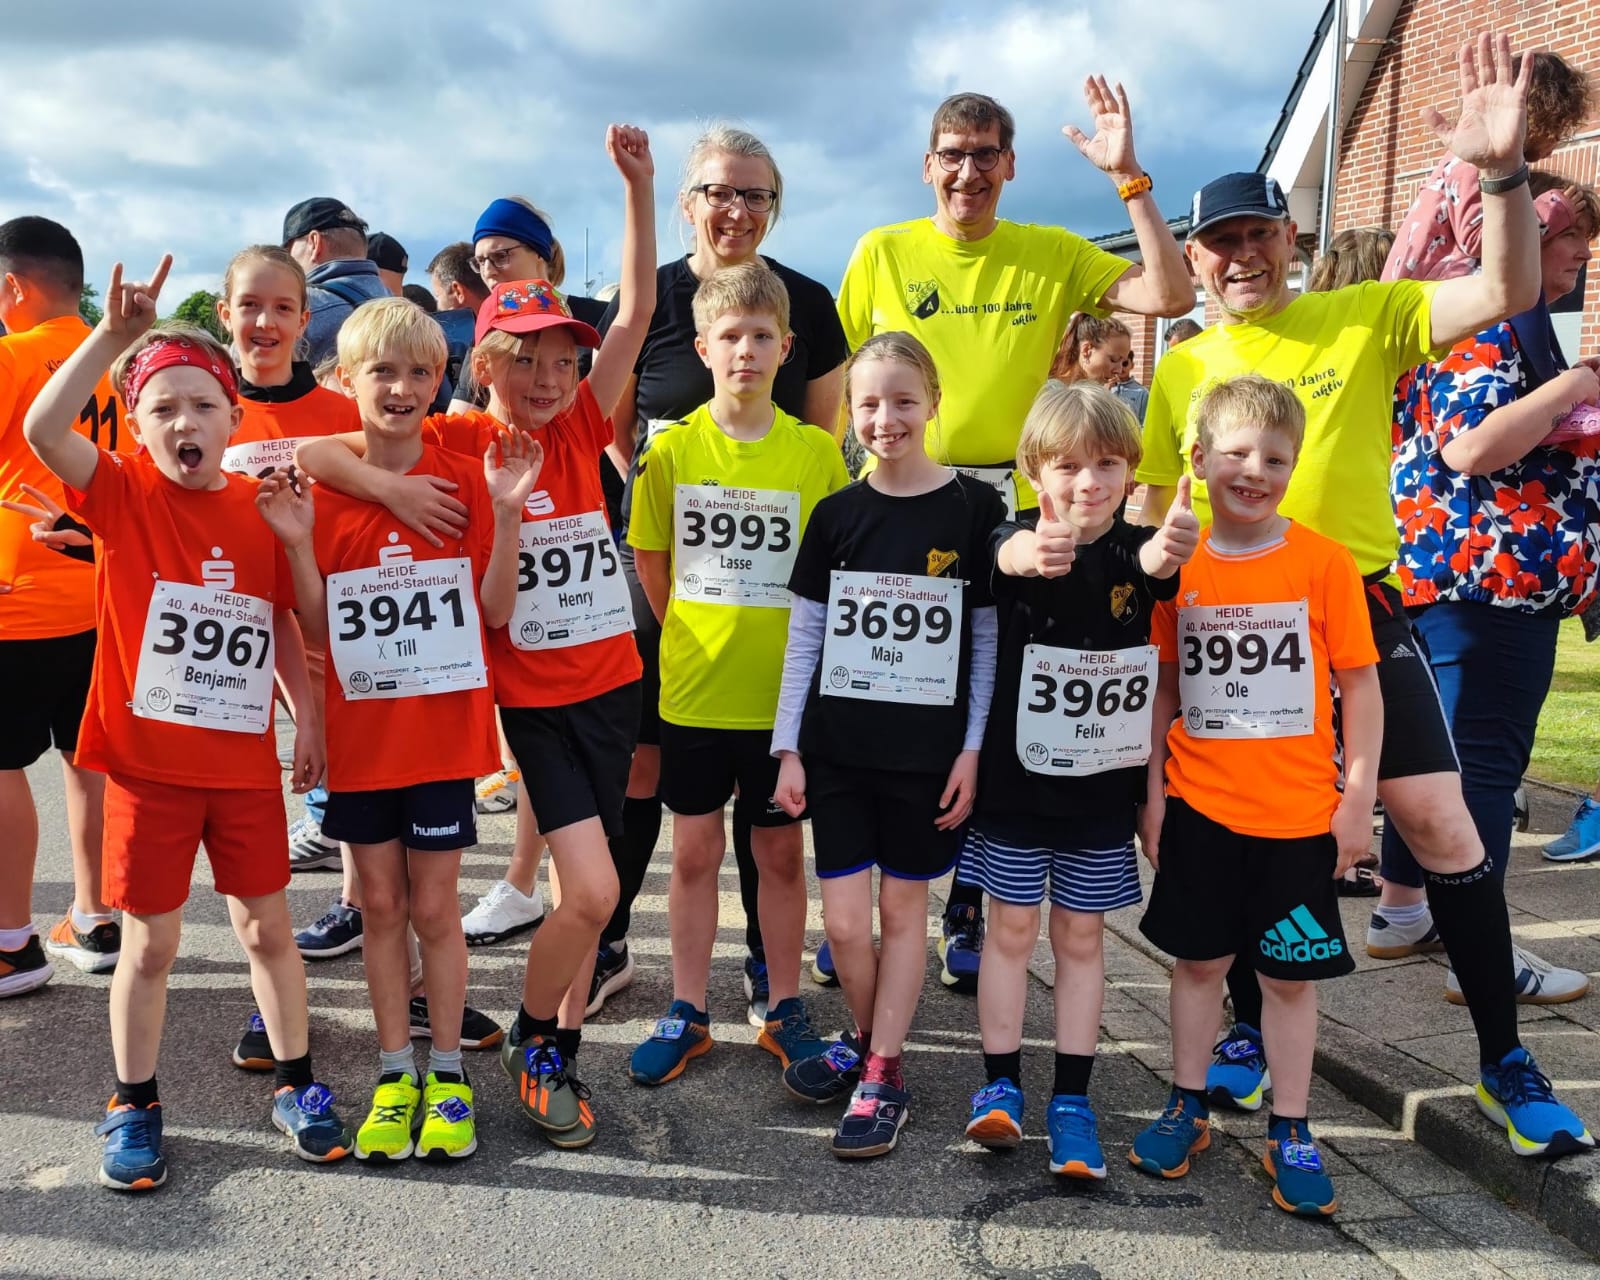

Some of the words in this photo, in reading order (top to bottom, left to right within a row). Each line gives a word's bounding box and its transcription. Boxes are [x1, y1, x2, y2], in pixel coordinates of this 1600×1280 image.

[908, 283, 920, 292] SV
[926, 301, 934, 311] A
[983, 303, 1000, 313] 100
[1004, 301, 1033, 313] Jahre
[1012, 313, 1038, 326] aktiv
[1300, 368, 1336, 387] Jahre
[1312, 379, 1343, 399] aktiv
[80, 394, 118, 452] 11
[262, 440, 296, 451] HEIDE
[723, 489, 757, 500] HEIDE
[687, 499, 701, 509] 40.
[705, 500, 788, 514] Abend-Stadtlauf
[549, 517, 584, 532] HEIDE
[682, 511, 791, 552] 3993
[518, 539, 528, 549] 0.
[518, 538, 617, 592] 3975
[720, 555, 752, 570] Lasse
[931, 554, 942, 562] SV
[378, 565, 417, 579] HEIDE
[340, 586, 357, 597] 40.
[361, 574, 458, 595] Abend-Stadtlauf
[876, 575, 912, 587] HEIDE
[214, 592, 251, 608] HEIDE
[559, 591, 593, 609] Henry
[842, 586, 856, 596] 40.
[859, 587, 948, 602] Abend-Stadtlauf
[167, 598, 185, 611] 40.
[1126, 606, 1132, 615] A
[1215, 607, 1253, 618] HEIDE
[338, 588, 465, 641] 3941
[833, 599, 953, 644] 3699
[1185, 622, 1197, 632] 40.
[1200, 618, 1296, 632] Abend-Stadtlauf
[152, 612, 270, 670] 3967
[395, 638, 417, 657] Till
[871, 646, 903, 666] Maja
[1080, 654, 1116, 664] HEIDE
[1184, 632, 1306, 677] 3994
[1036, 660, 1053, 672] 40.
[1058, 662, 1147, 676] Abend-Stadtlauf
[184, 665, 247, 691] Benjamin
[1028, 673, 1149, 717] 3968
[1225, 681, 1249, 698] Ole
[1270, 707, 1303, 716] northvolt
[1075, 723, 1105, 739] Felix
[412, 821, 460, 836] hummel
[1260, 938, 1342, 962] adidas
